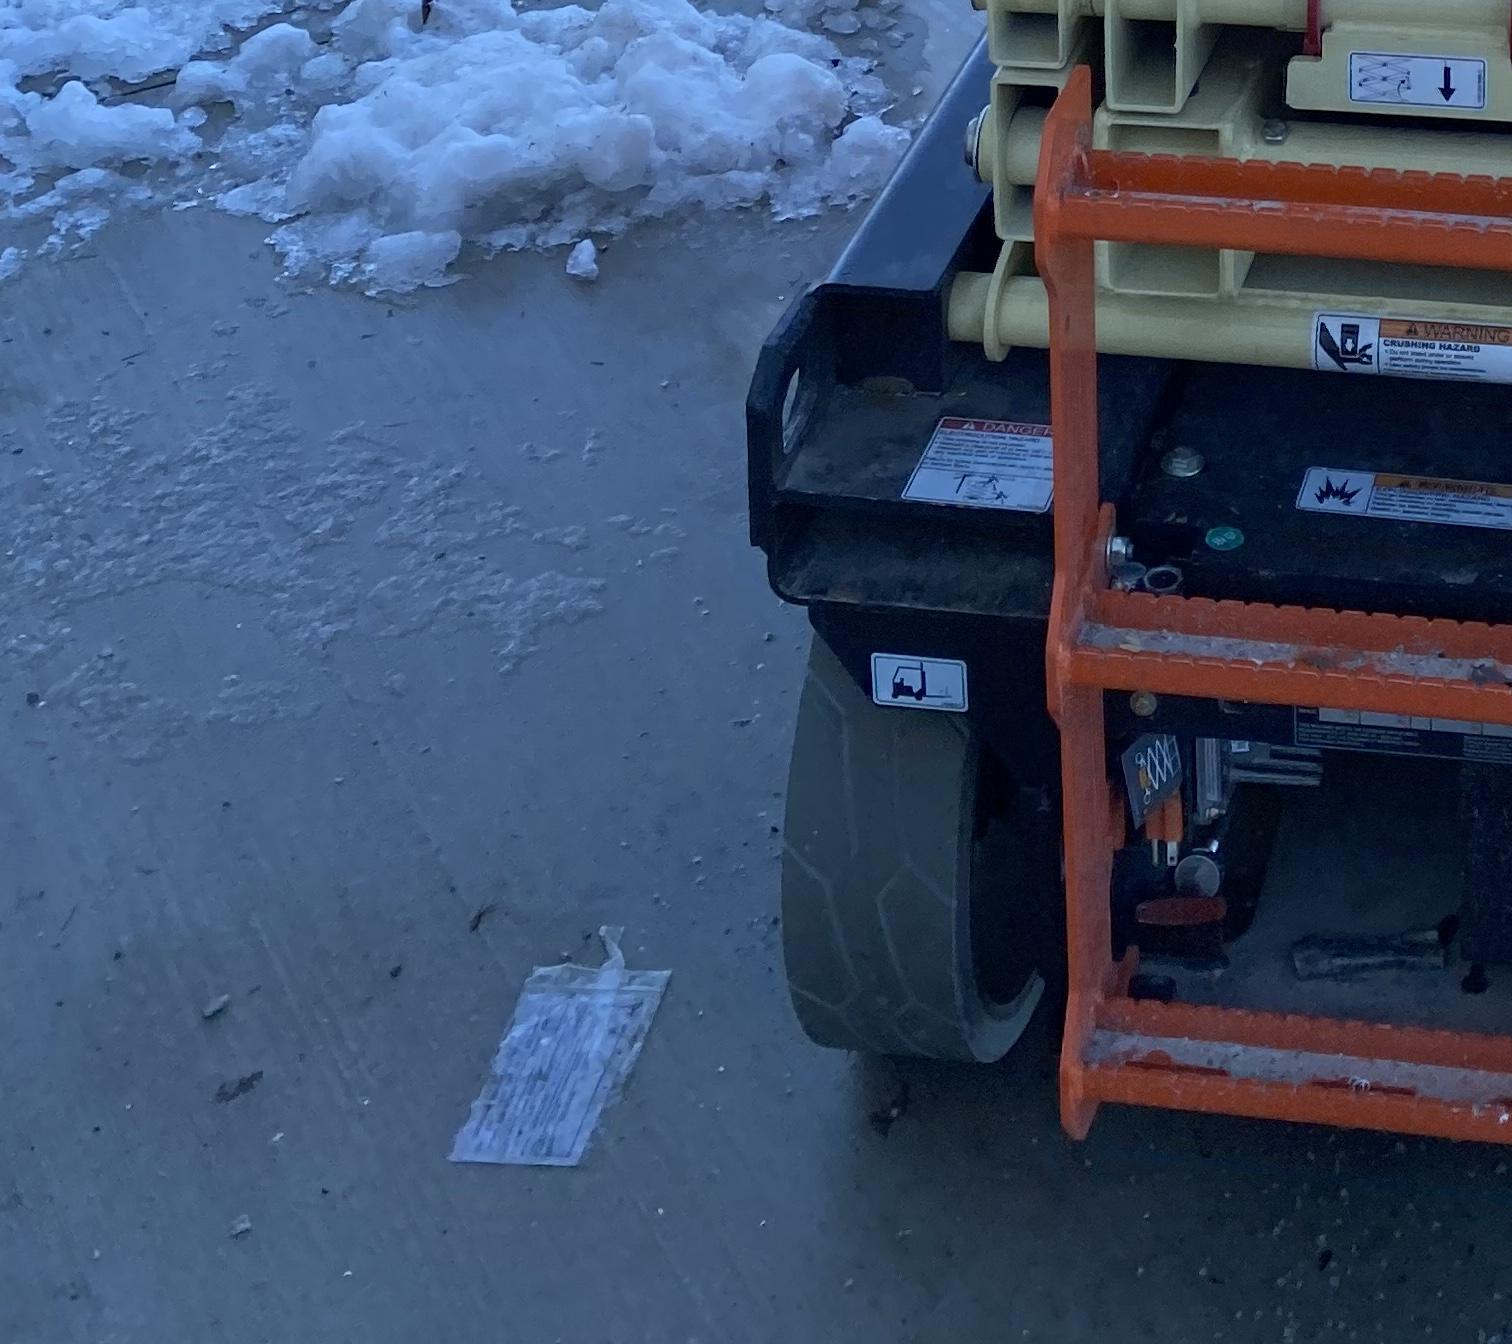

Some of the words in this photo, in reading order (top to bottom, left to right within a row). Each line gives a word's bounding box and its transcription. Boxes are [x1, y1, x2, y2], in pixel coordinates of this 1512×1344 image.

[1424, 323, 1511, 343] WARNING
[1383, 339, 1435, 350] CRUSHING
[1439, 343, 1480, 353] HAZARD
